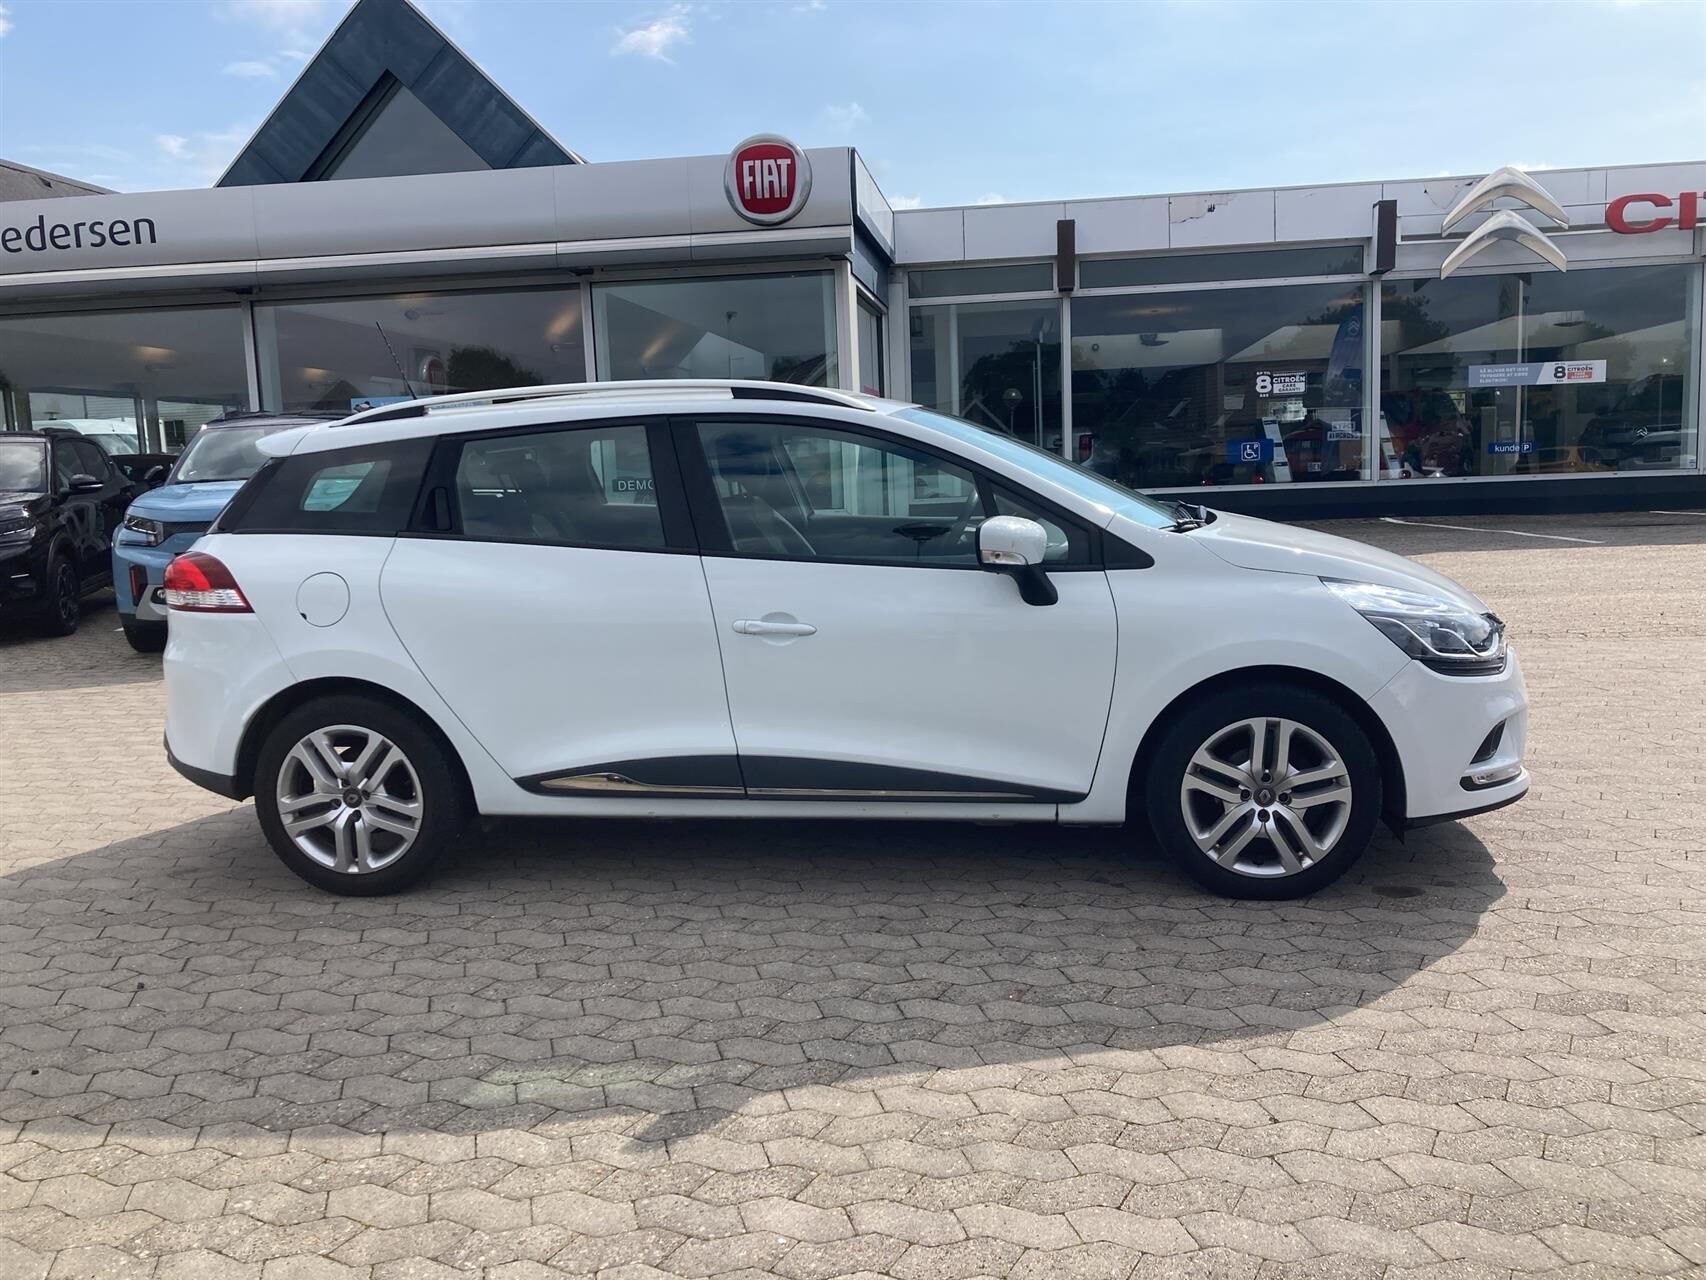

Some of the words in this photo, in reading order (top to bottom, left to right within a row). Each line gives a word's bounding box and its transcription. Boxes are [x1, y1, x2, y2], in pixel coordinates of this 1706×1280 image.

[743, 158, 791, 200] FIAT
[1605, 191, 1706, 235] CI
[0, 215, 157, 253] edersen
[1273, 375, 1306, 384] CITROËN
[1553, 365, 1566, 379] 8
[1256, 375, 1272, 393] 8
[1494, 444, 1520, 452] kunde
